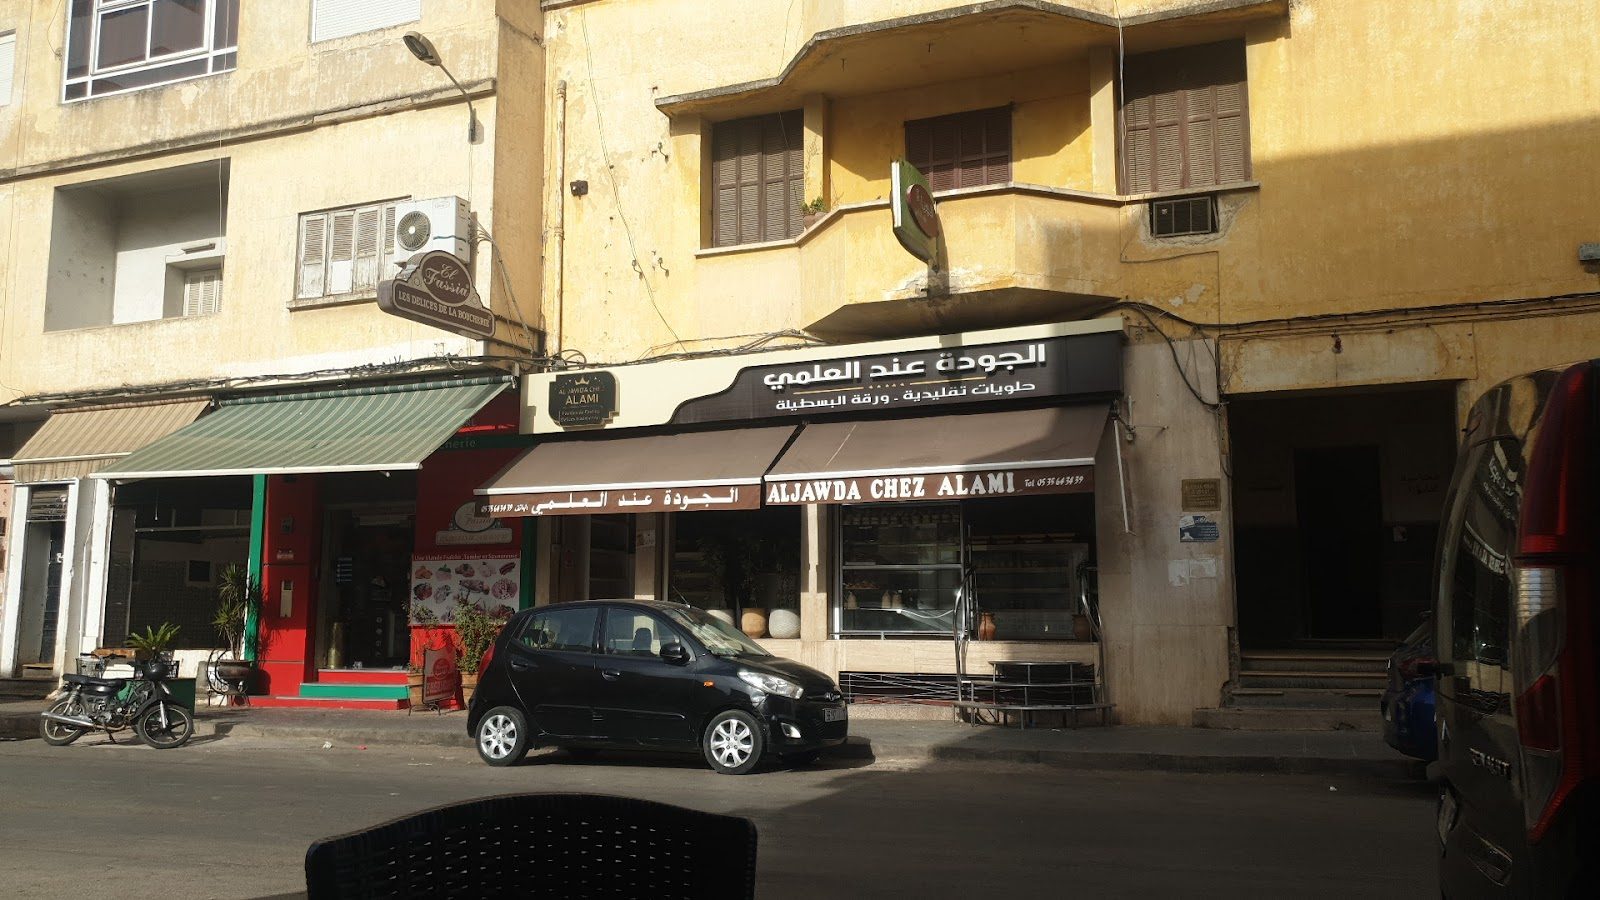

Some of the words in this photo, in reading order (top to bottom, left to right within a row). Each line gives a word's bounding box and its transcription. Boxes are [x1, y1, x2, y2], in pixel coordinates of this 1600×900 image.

[398, 290, 411, 302] LES
[411, 294, 438, 312] DELICES
[438, 304, 448, 315] DE
[448, 306, 457, 317] LA
[458, 310, 490, 328] BOUCHERIE
[869, 357, 926, 380] عند
[936, 343, 1047, 371] الجودة
[763, 360, 861, 391] العلمي
[565, 393, 599, 405] ALAMI
[851, 393, 890, 406] ورقة
[902, 385, 967, 402] تقليدية
[971, 380, 1036, 396] حلويات
[775, 395, 847, 411] البسطيلة
[663, 487, 739, 511] الجودة
[767, 480, 861, 503] ALJAWDA
[870, 476, 926, 499] CHEZ
[937, 472, 1015, 497] ALAMI
[531, 491, 608, 515] العلمي
[618, 492, 653, 507] عند
